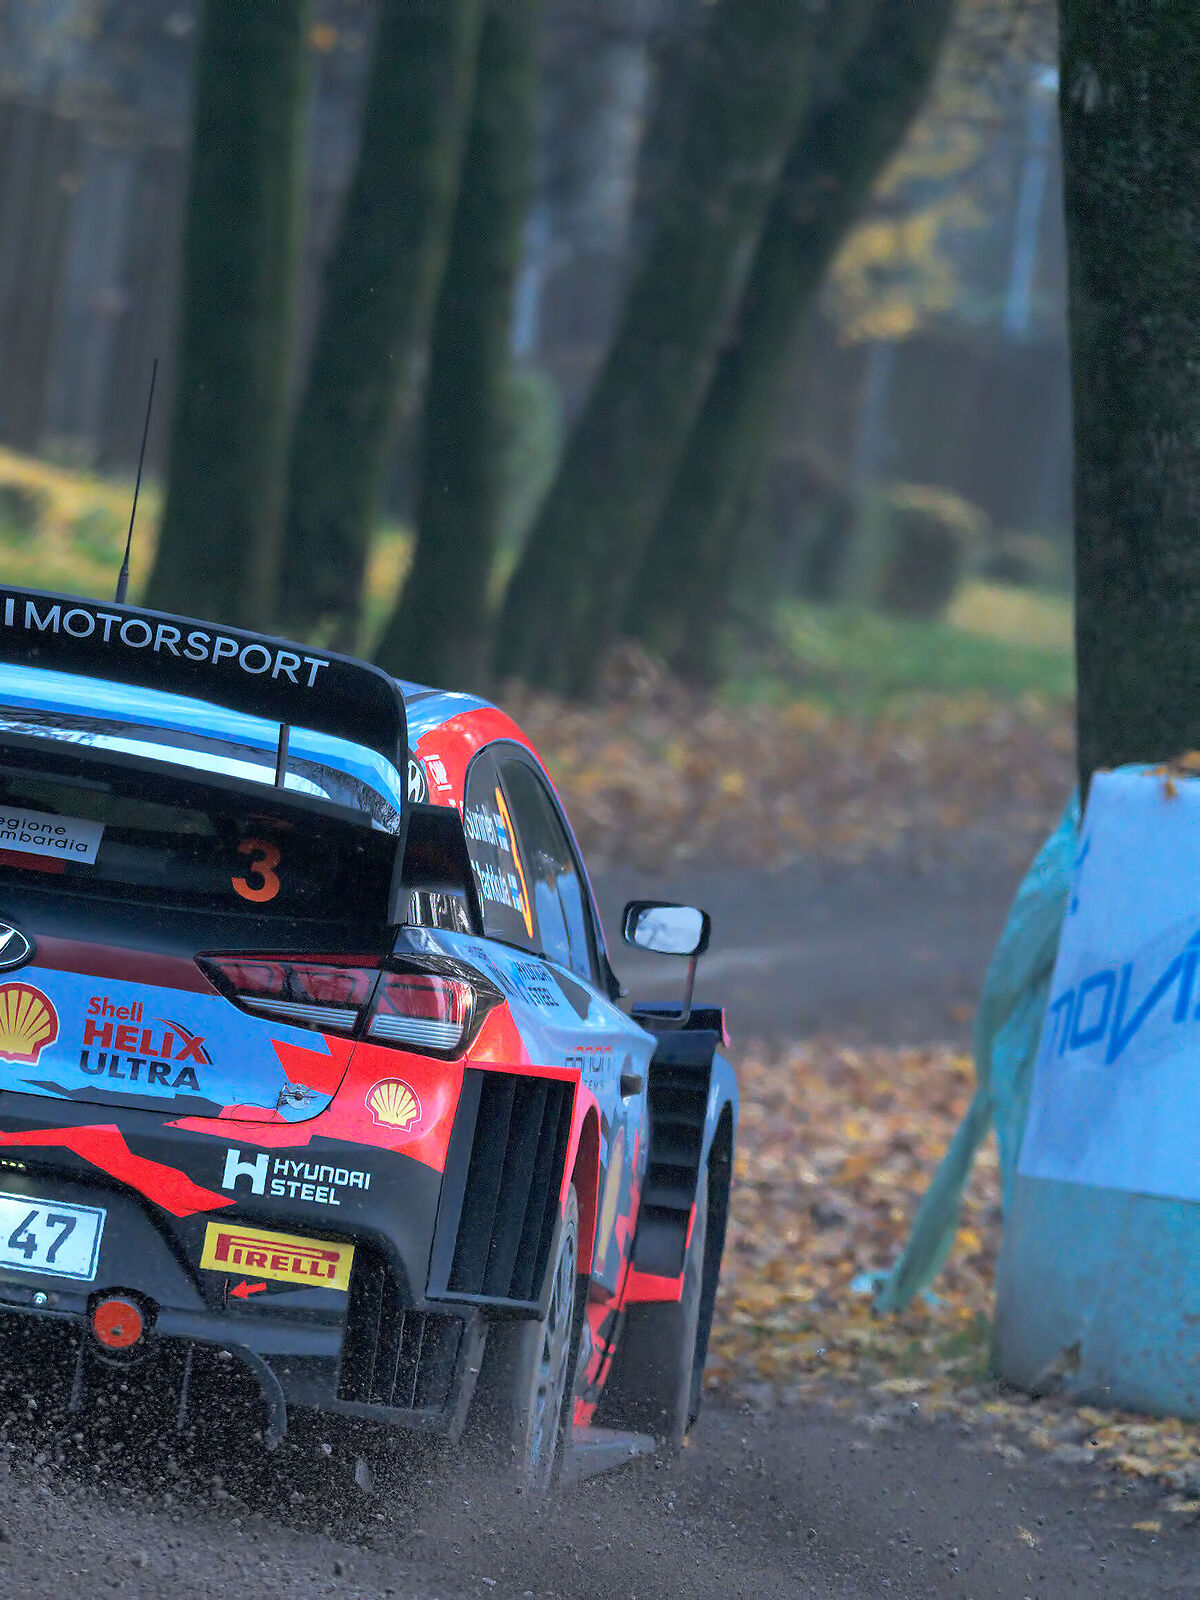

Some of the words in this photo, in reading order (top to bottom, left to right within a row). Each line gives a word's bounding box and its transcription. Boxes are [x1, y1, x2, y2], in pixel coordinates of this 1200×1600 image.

[24, 602, 330, 688] MOTORSPORT
[231, 838, 282, 902] 3
[87, 996, 144, 1023] Shell
[83, 1018, 211, 1065] HELIX
[80, 1049, 201, 1092] ULTRA
[270, 1178, 340, 1206] STEEL
[272, 1157, 372, 1190] HYUNDAI
[7, 1209, 78, 1264] 47
[214, 1232, 341, 1280] PIRELLI
